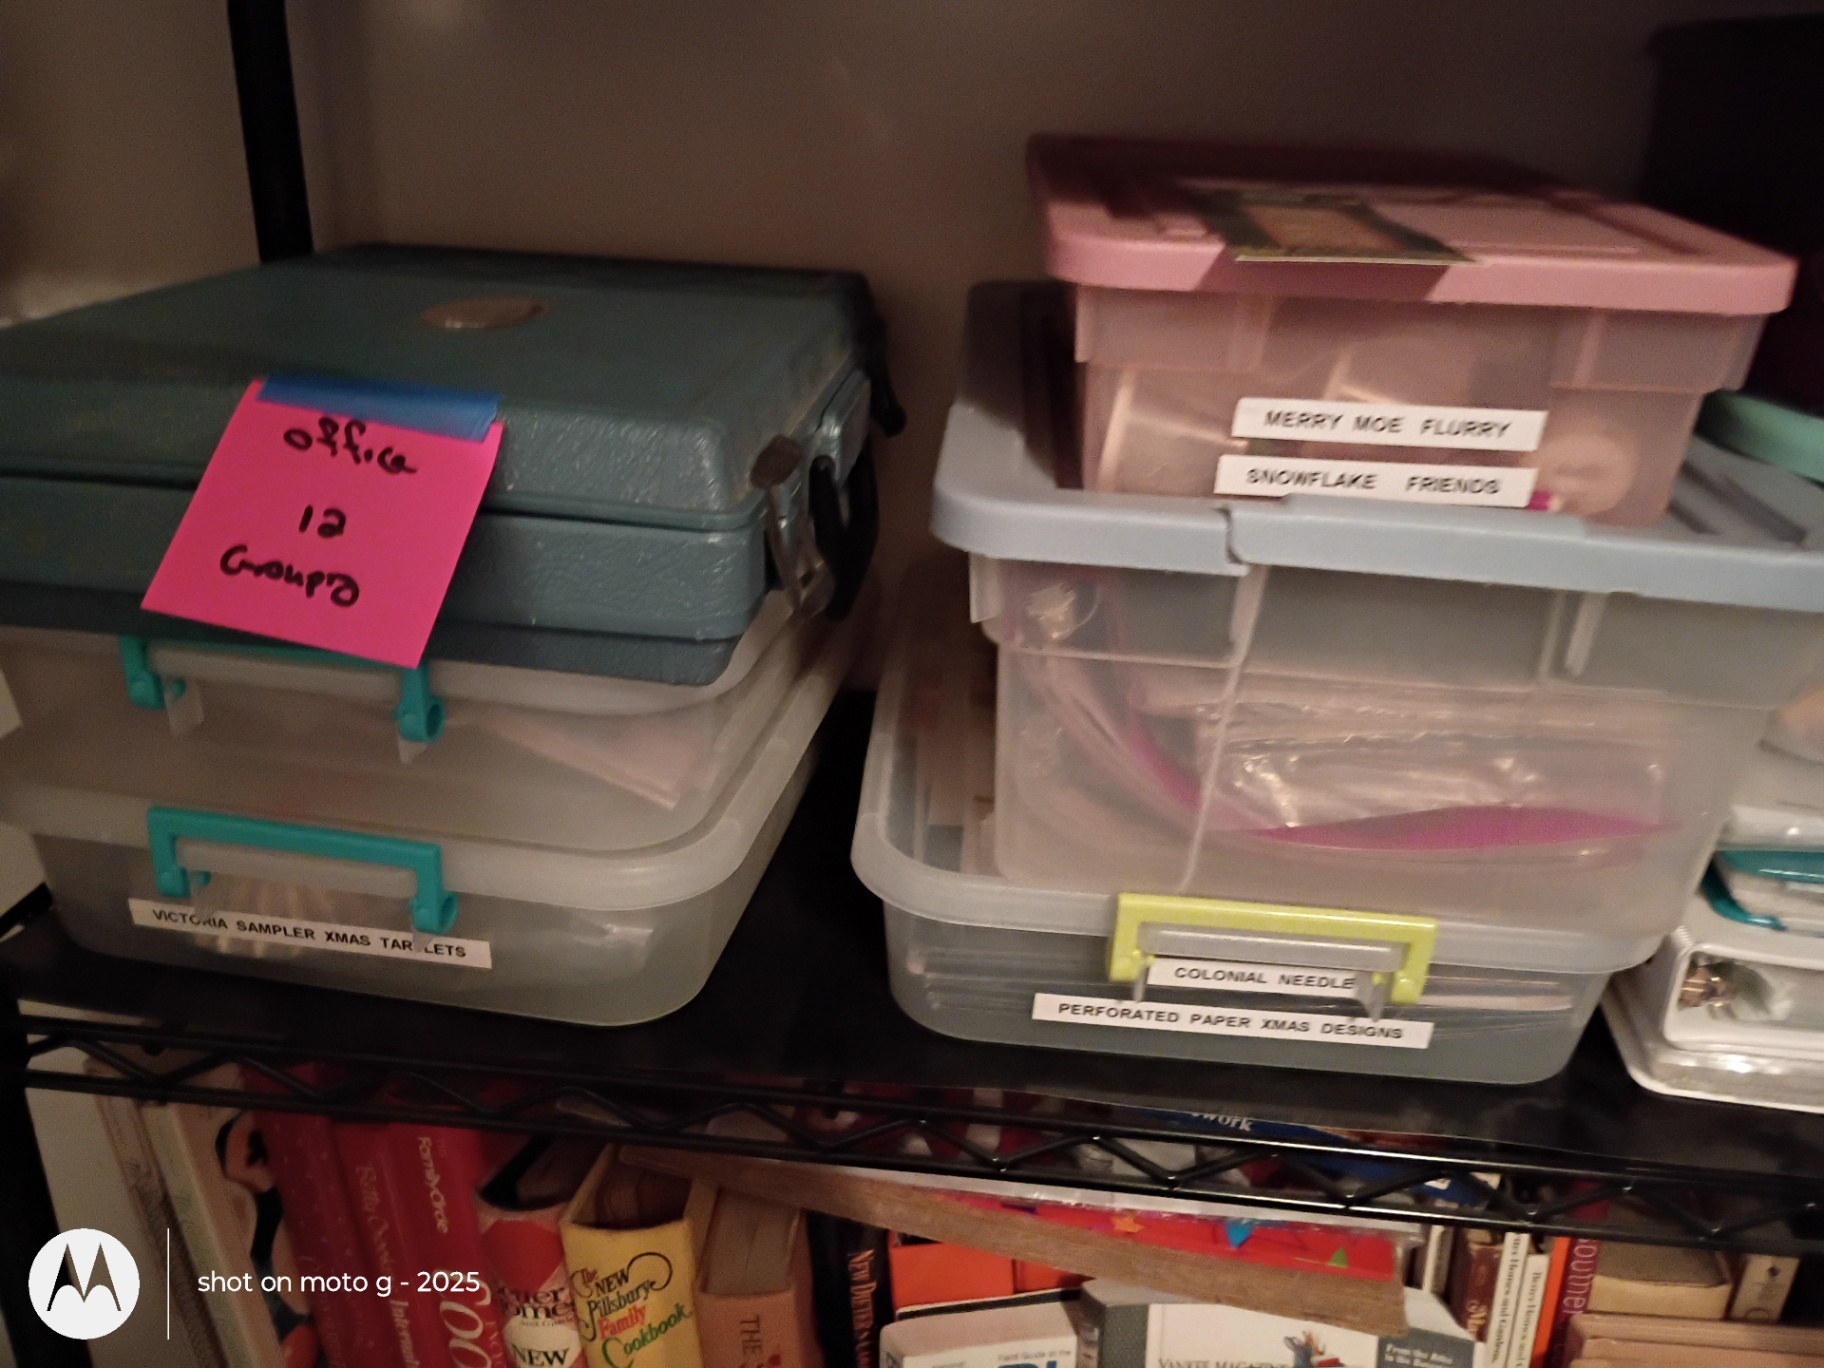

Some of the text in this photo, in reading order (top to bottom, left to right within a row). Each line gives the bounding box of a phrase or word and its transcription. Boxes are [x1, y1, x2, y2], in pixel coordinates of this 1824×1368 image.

[1264, 410, 1511, 438] MERRY MOE FLURRY
[1246, 467, 1500, 496] SNOWFLAKE FRIENDS
[152, 908, 467, 958] VICTORIA SAMPLER XMAS TARLETS
[1174, 966, 1356, 991] COLONIAL NEEDLE
[1058, 1003, 1403, 1040] PERFORATED PAPER XMAS DESIGNS
[571, 1268, 598, 1298] The
[595, 1268, 631, 1298] NEW
[579, 1279, 656, 1342] Pillsbury
[598, 1303, 647, 1340] Family
[602, 1302, 691, 1368] Cookbook
[740, 1315, 762, 1355] THE
[512, 1343, 570, 1368] NEW
